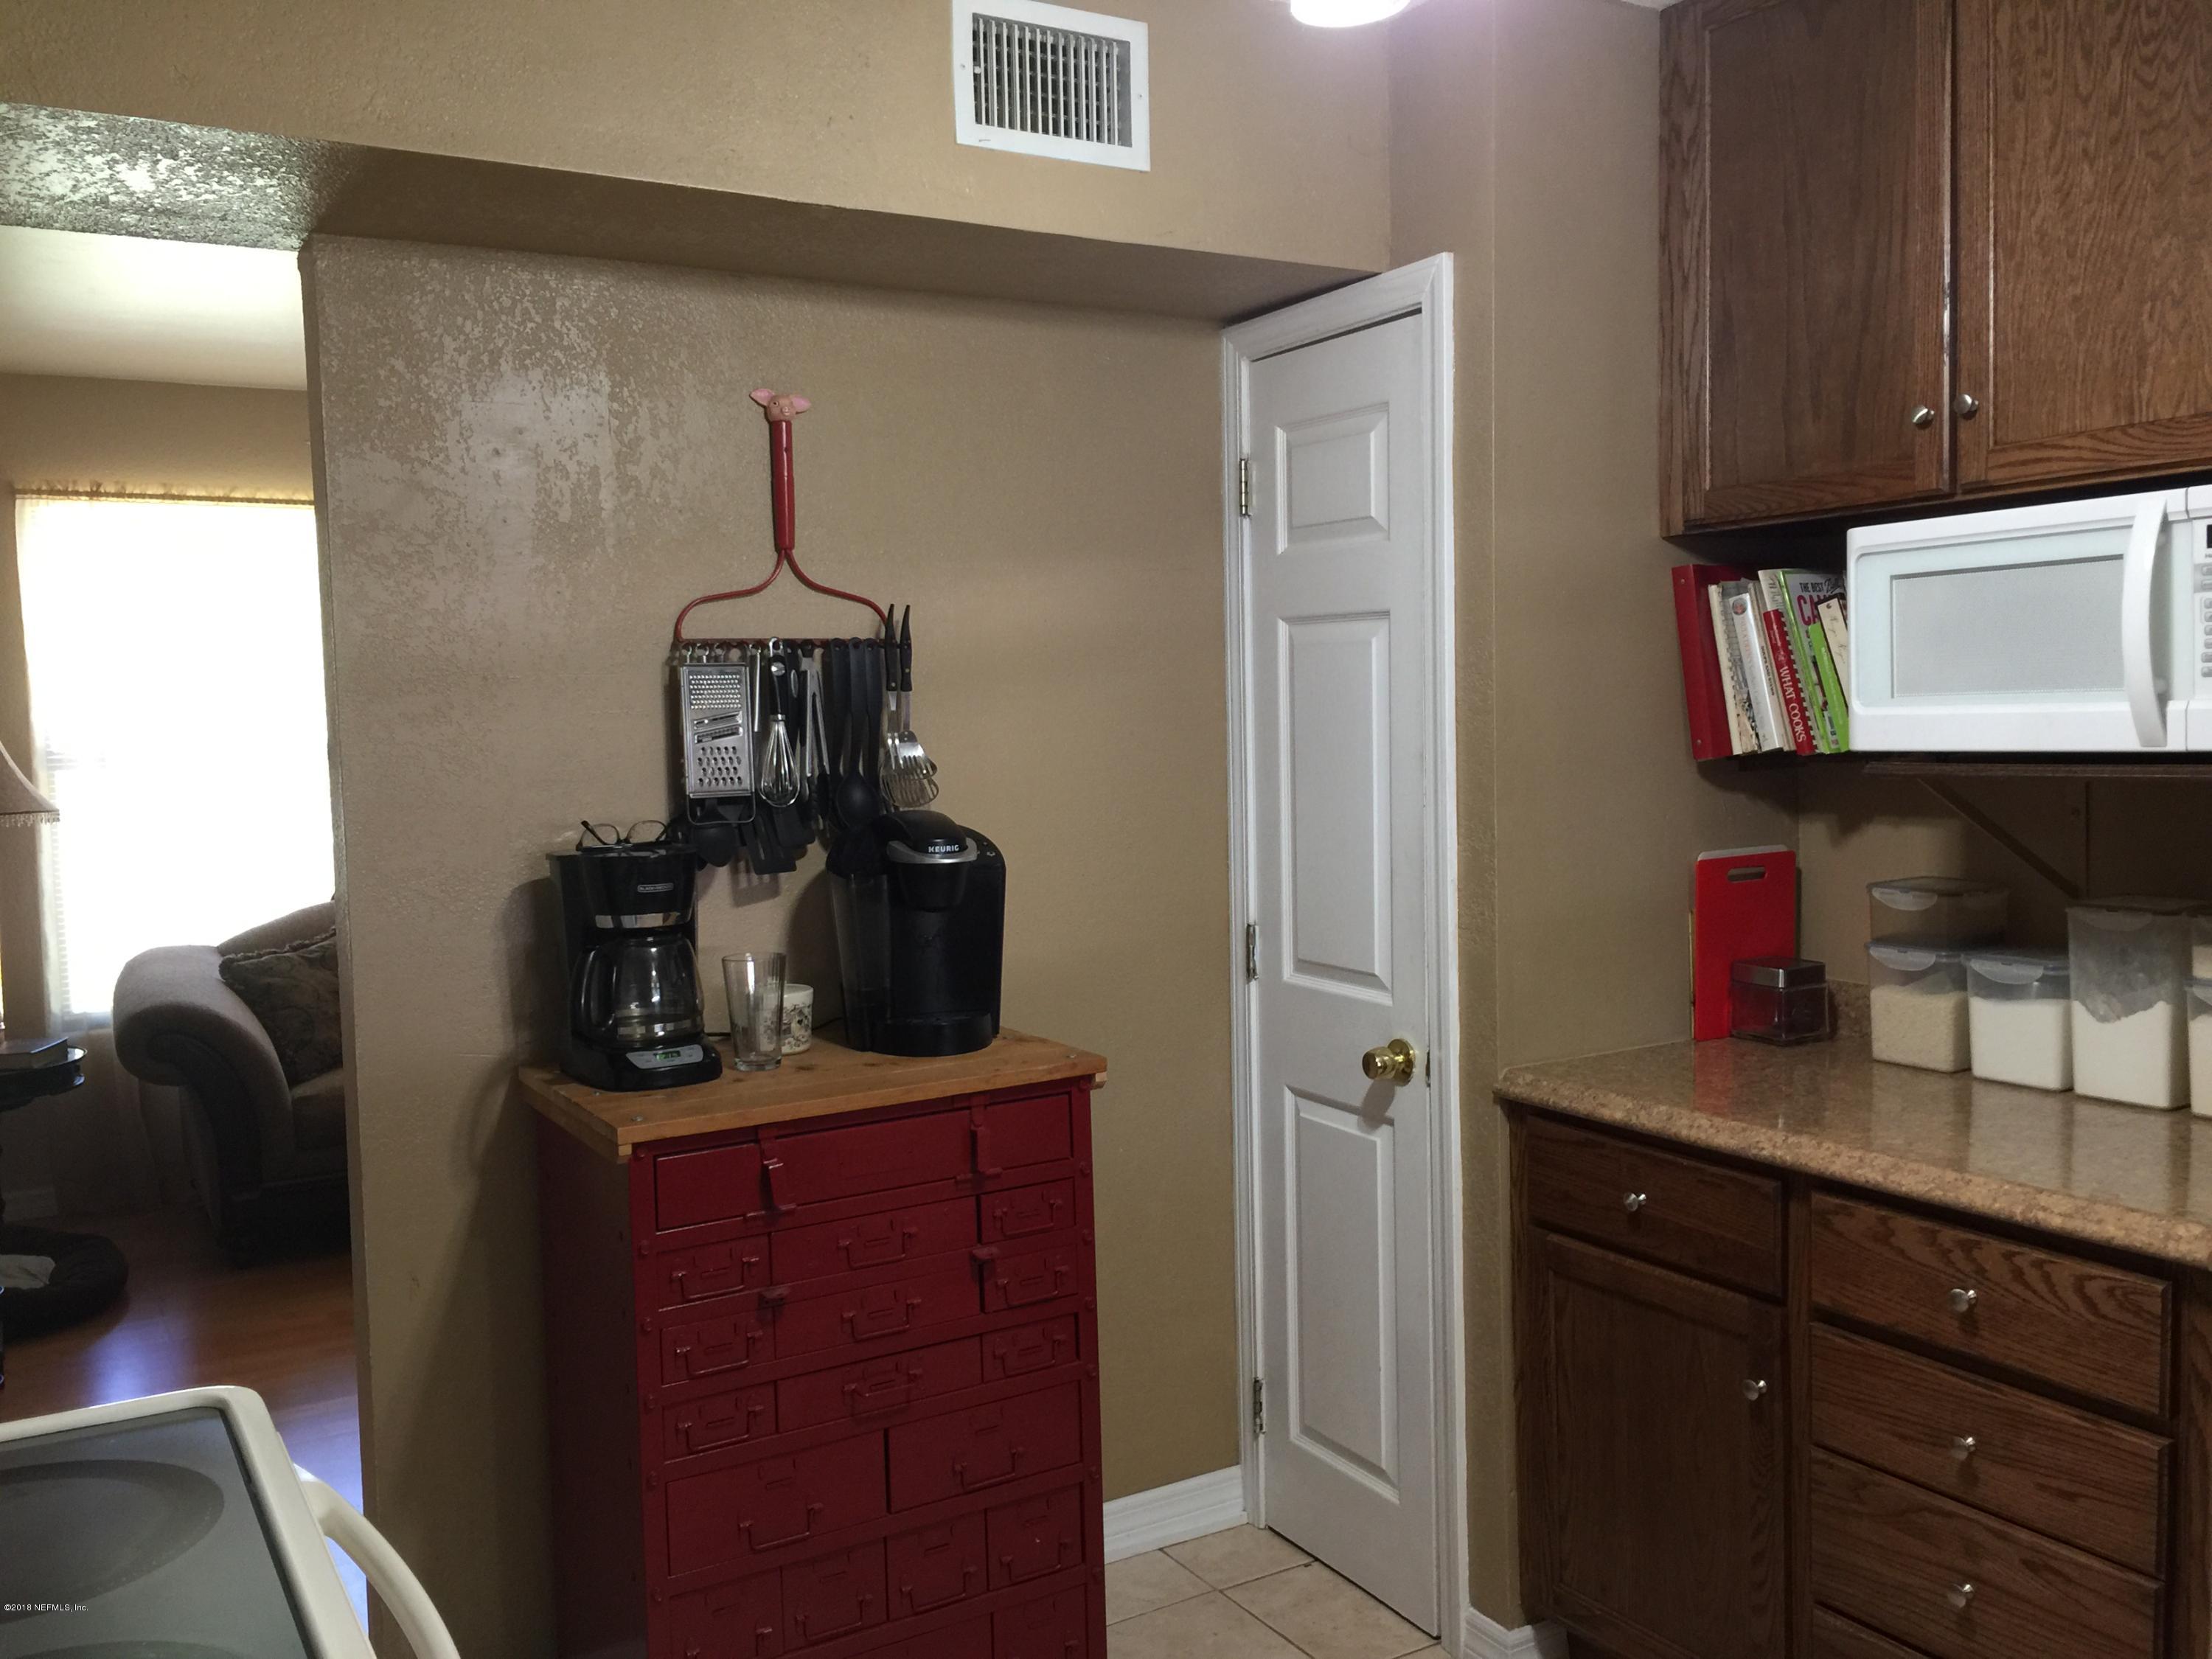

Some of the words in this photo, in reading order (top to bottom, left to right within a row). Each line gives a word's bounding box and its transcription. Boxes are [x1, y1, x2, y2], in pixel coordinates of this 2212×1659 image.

[1779, 666, 1795, 699] WHAT
[1788, 702, 1806, 743] COOKS
[928, 844, 960, 853] KEURIG
